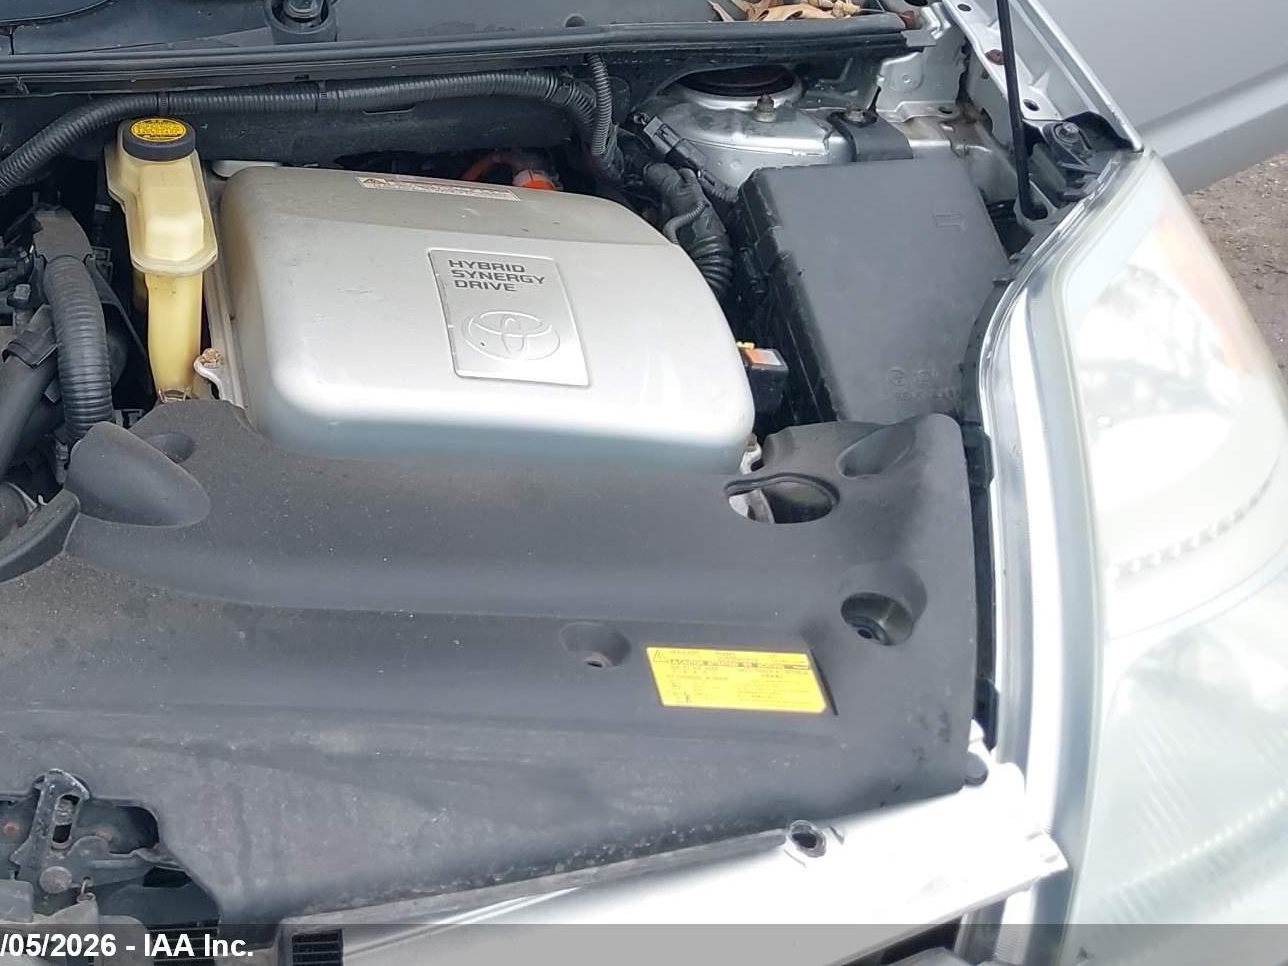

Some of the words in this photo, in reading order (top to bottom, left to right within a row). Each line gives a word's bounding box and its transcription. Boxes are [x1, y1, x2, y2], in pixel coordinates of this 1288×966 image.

[448, 259, 526, 273] HYBRID
[451, 269, 546, 285] SYNERGY
[454, 279, 517, 292] DRIVE
